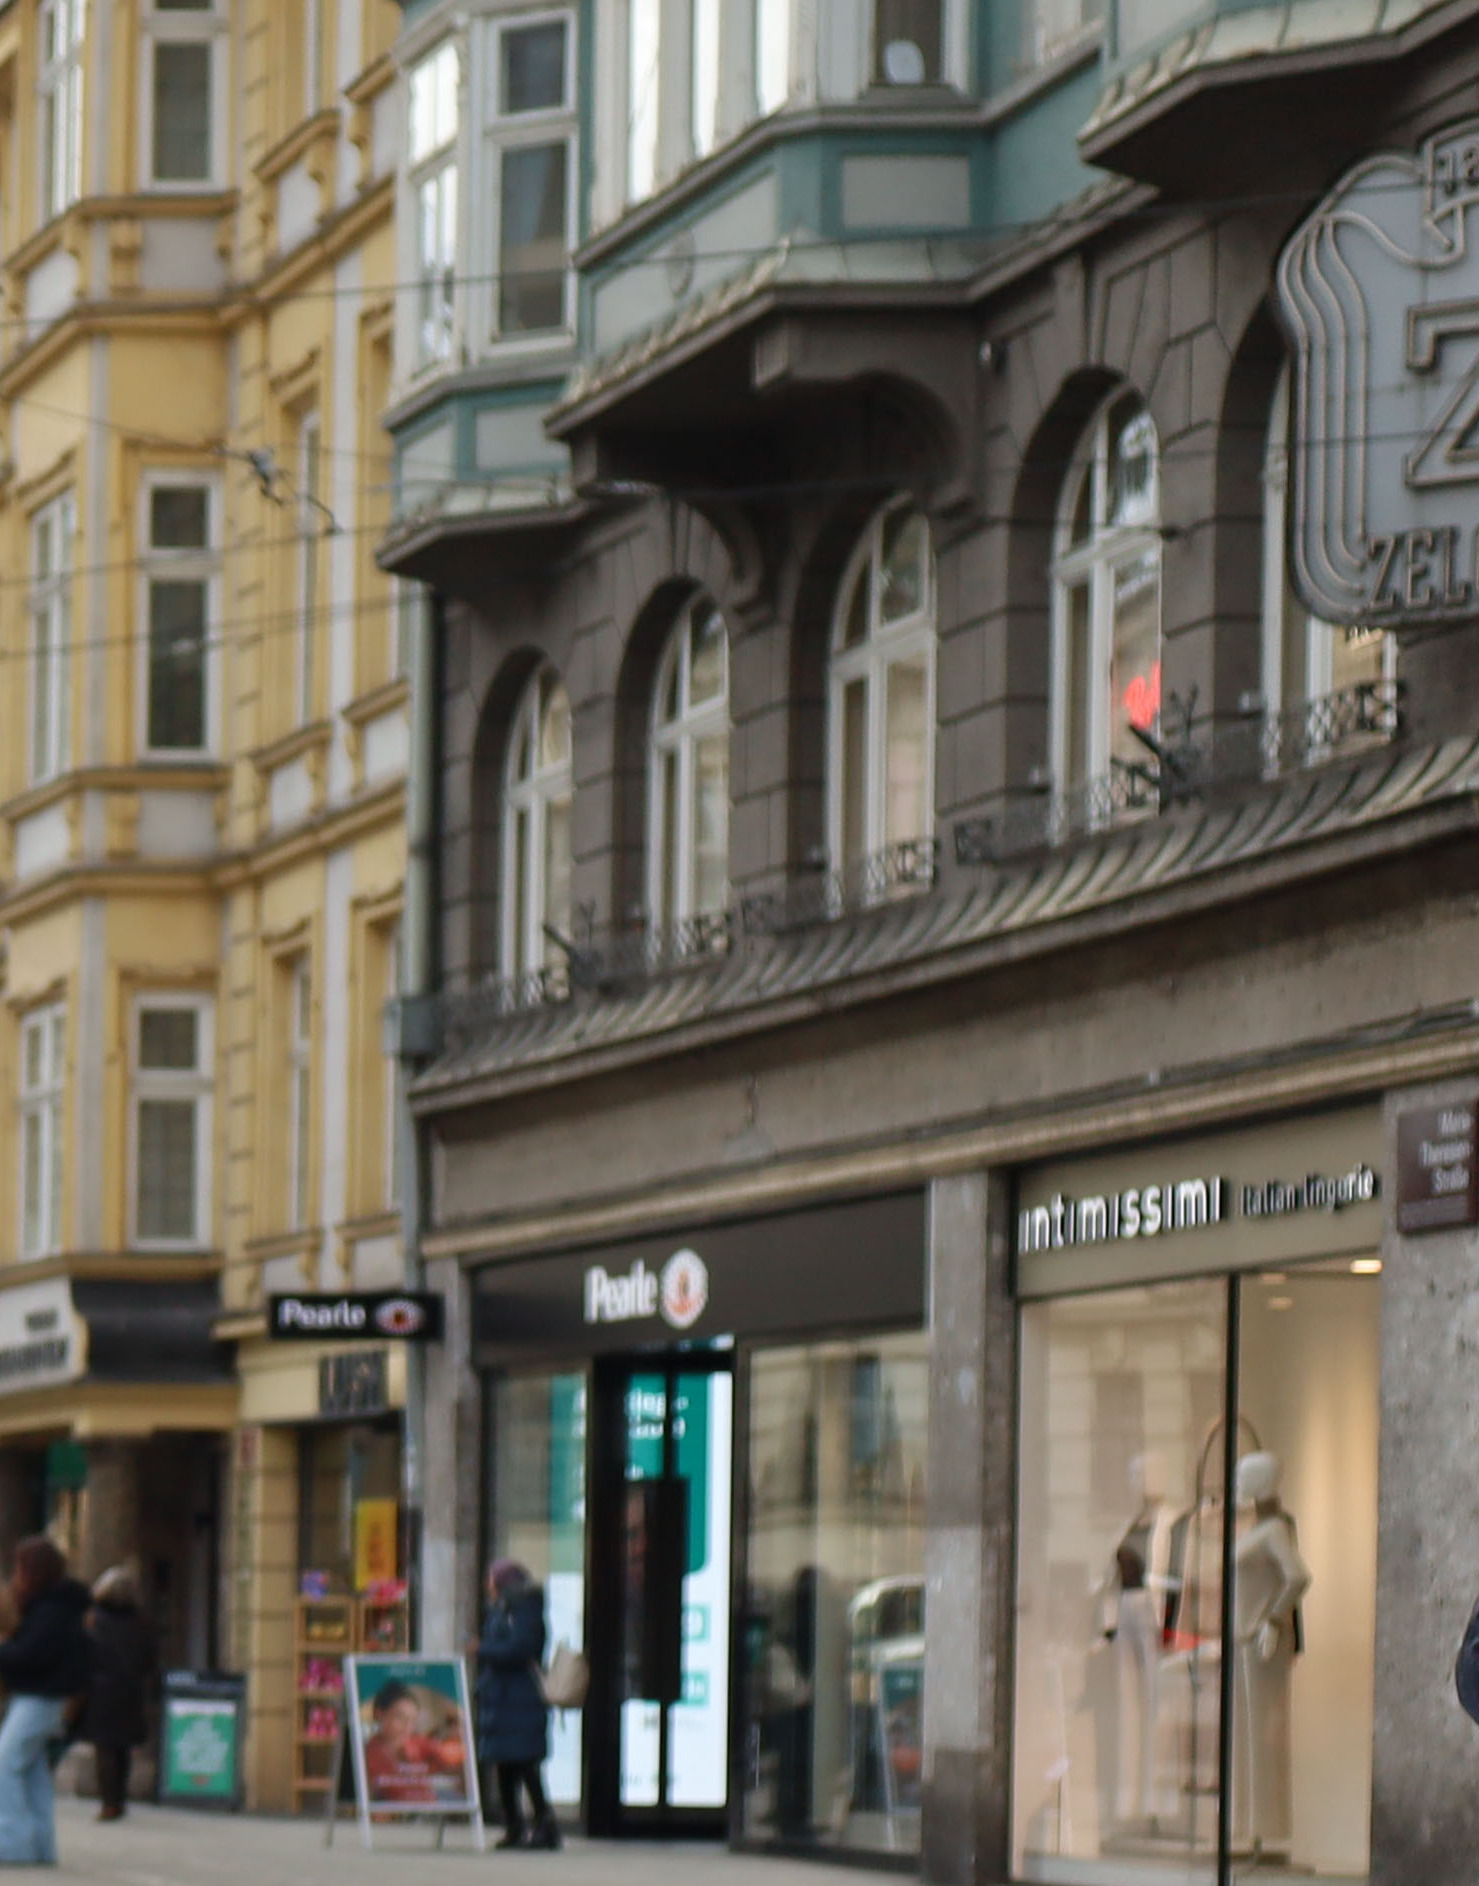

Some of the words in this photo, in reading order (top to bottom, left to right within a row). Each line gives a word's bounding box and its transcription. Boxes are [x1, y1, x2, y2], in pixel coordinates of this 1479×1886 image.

[1368, 524, 1479, 612] ZEL
[278, 1299, 366, 1329] Pearle
[584, 1258, 658, 1324] Pearle
